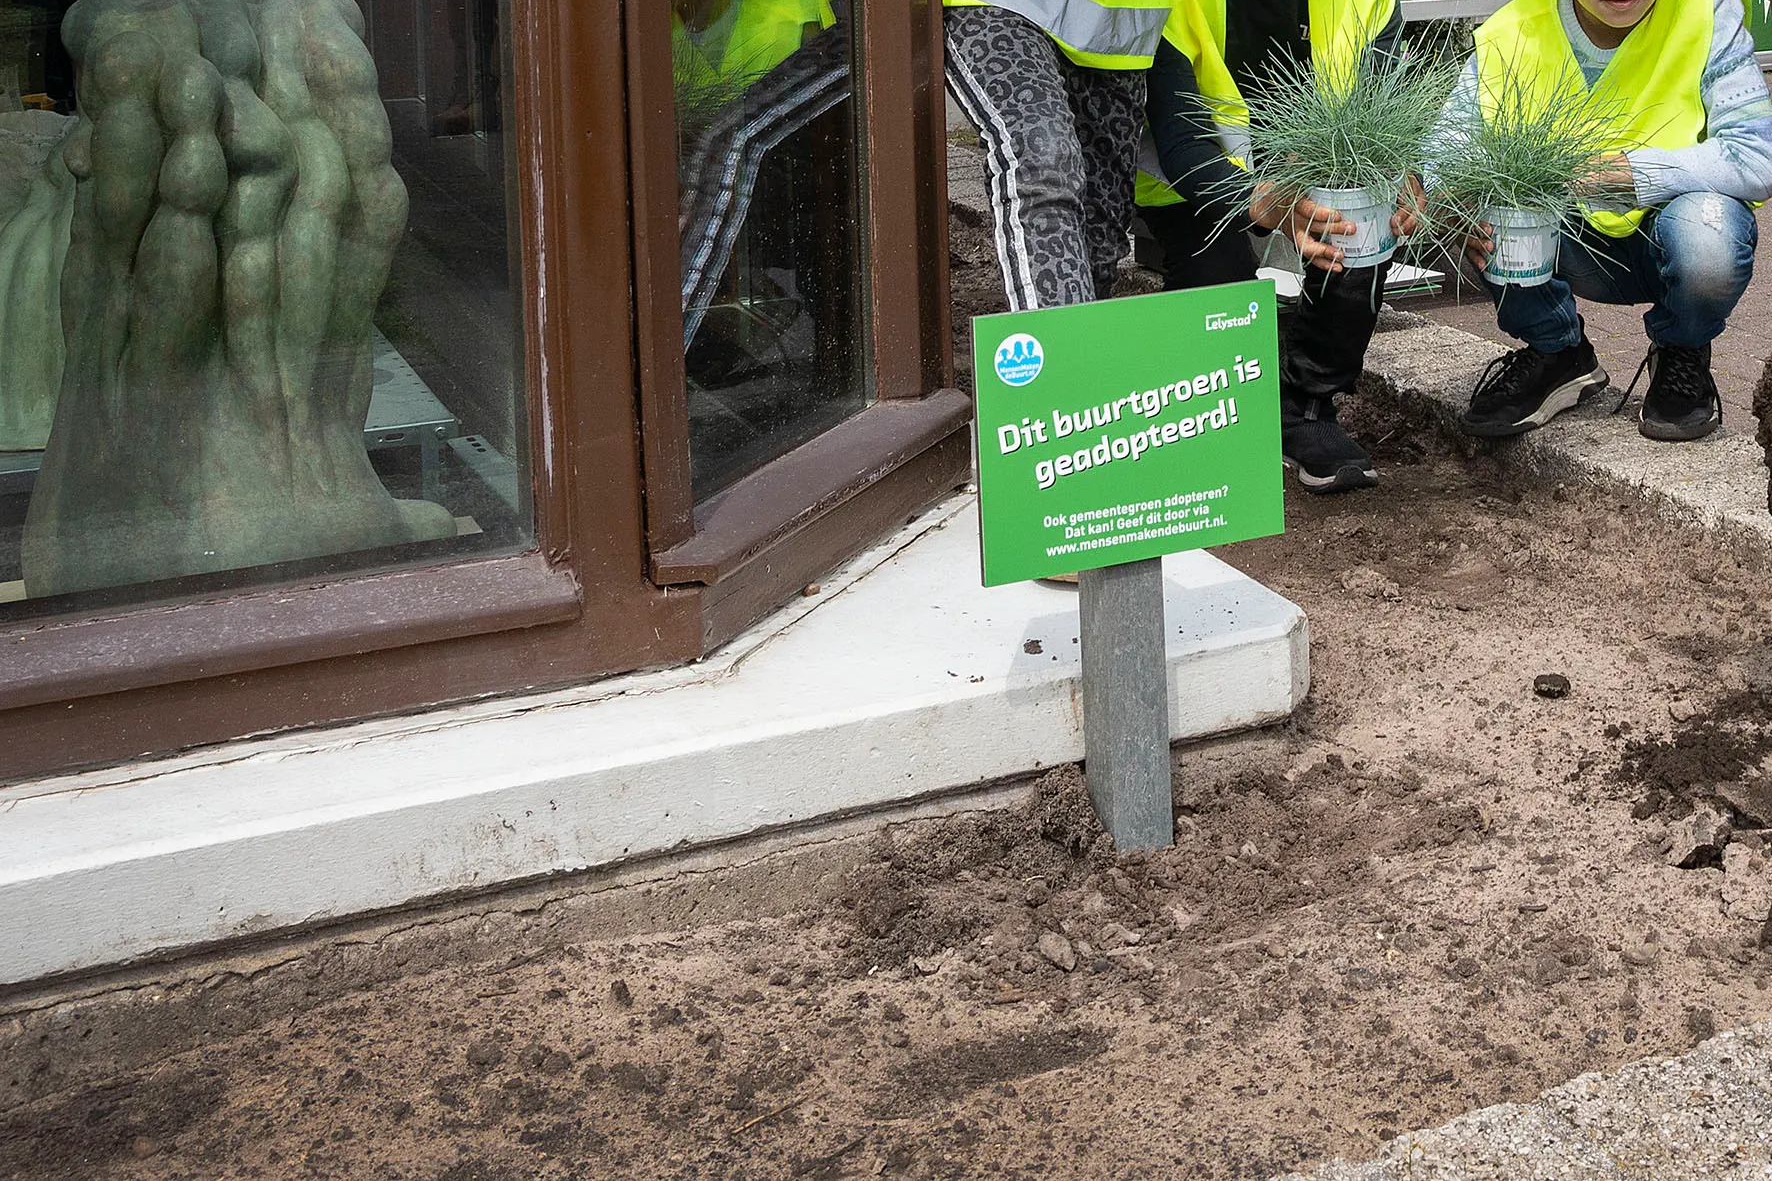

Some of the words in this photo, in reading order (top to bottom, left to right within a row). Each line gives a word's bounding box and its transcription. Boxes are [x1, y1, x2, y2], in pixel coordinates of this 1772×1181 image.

[1205, 313, 1251, 331] Lelystad
[997, 418, 1048, 455] Dit
[1052, 368, 1229, 439] buurtgroen
[1233, 355, 1262, 383] is
[1034, 397, 1239, 490] geadopteerd!
[1043, 515, 1067, 528] Ook
[1069, 498, 1162, 527] gemeentegroen
[1164, 484, 1230, 507] adopteren?
[1065, 525, 1086, 539] Dat
[1088, 520, 1114, 536] kan!
[1117, 515, 1144, 529] Geef
[1146, 512, 1162, 526] dit
[1164, 507, 1191, 522] door
[1193, 504, 1209, 515] via
[1046, 514, 1228, 557] www.mensenmakendebuurt.nl.
